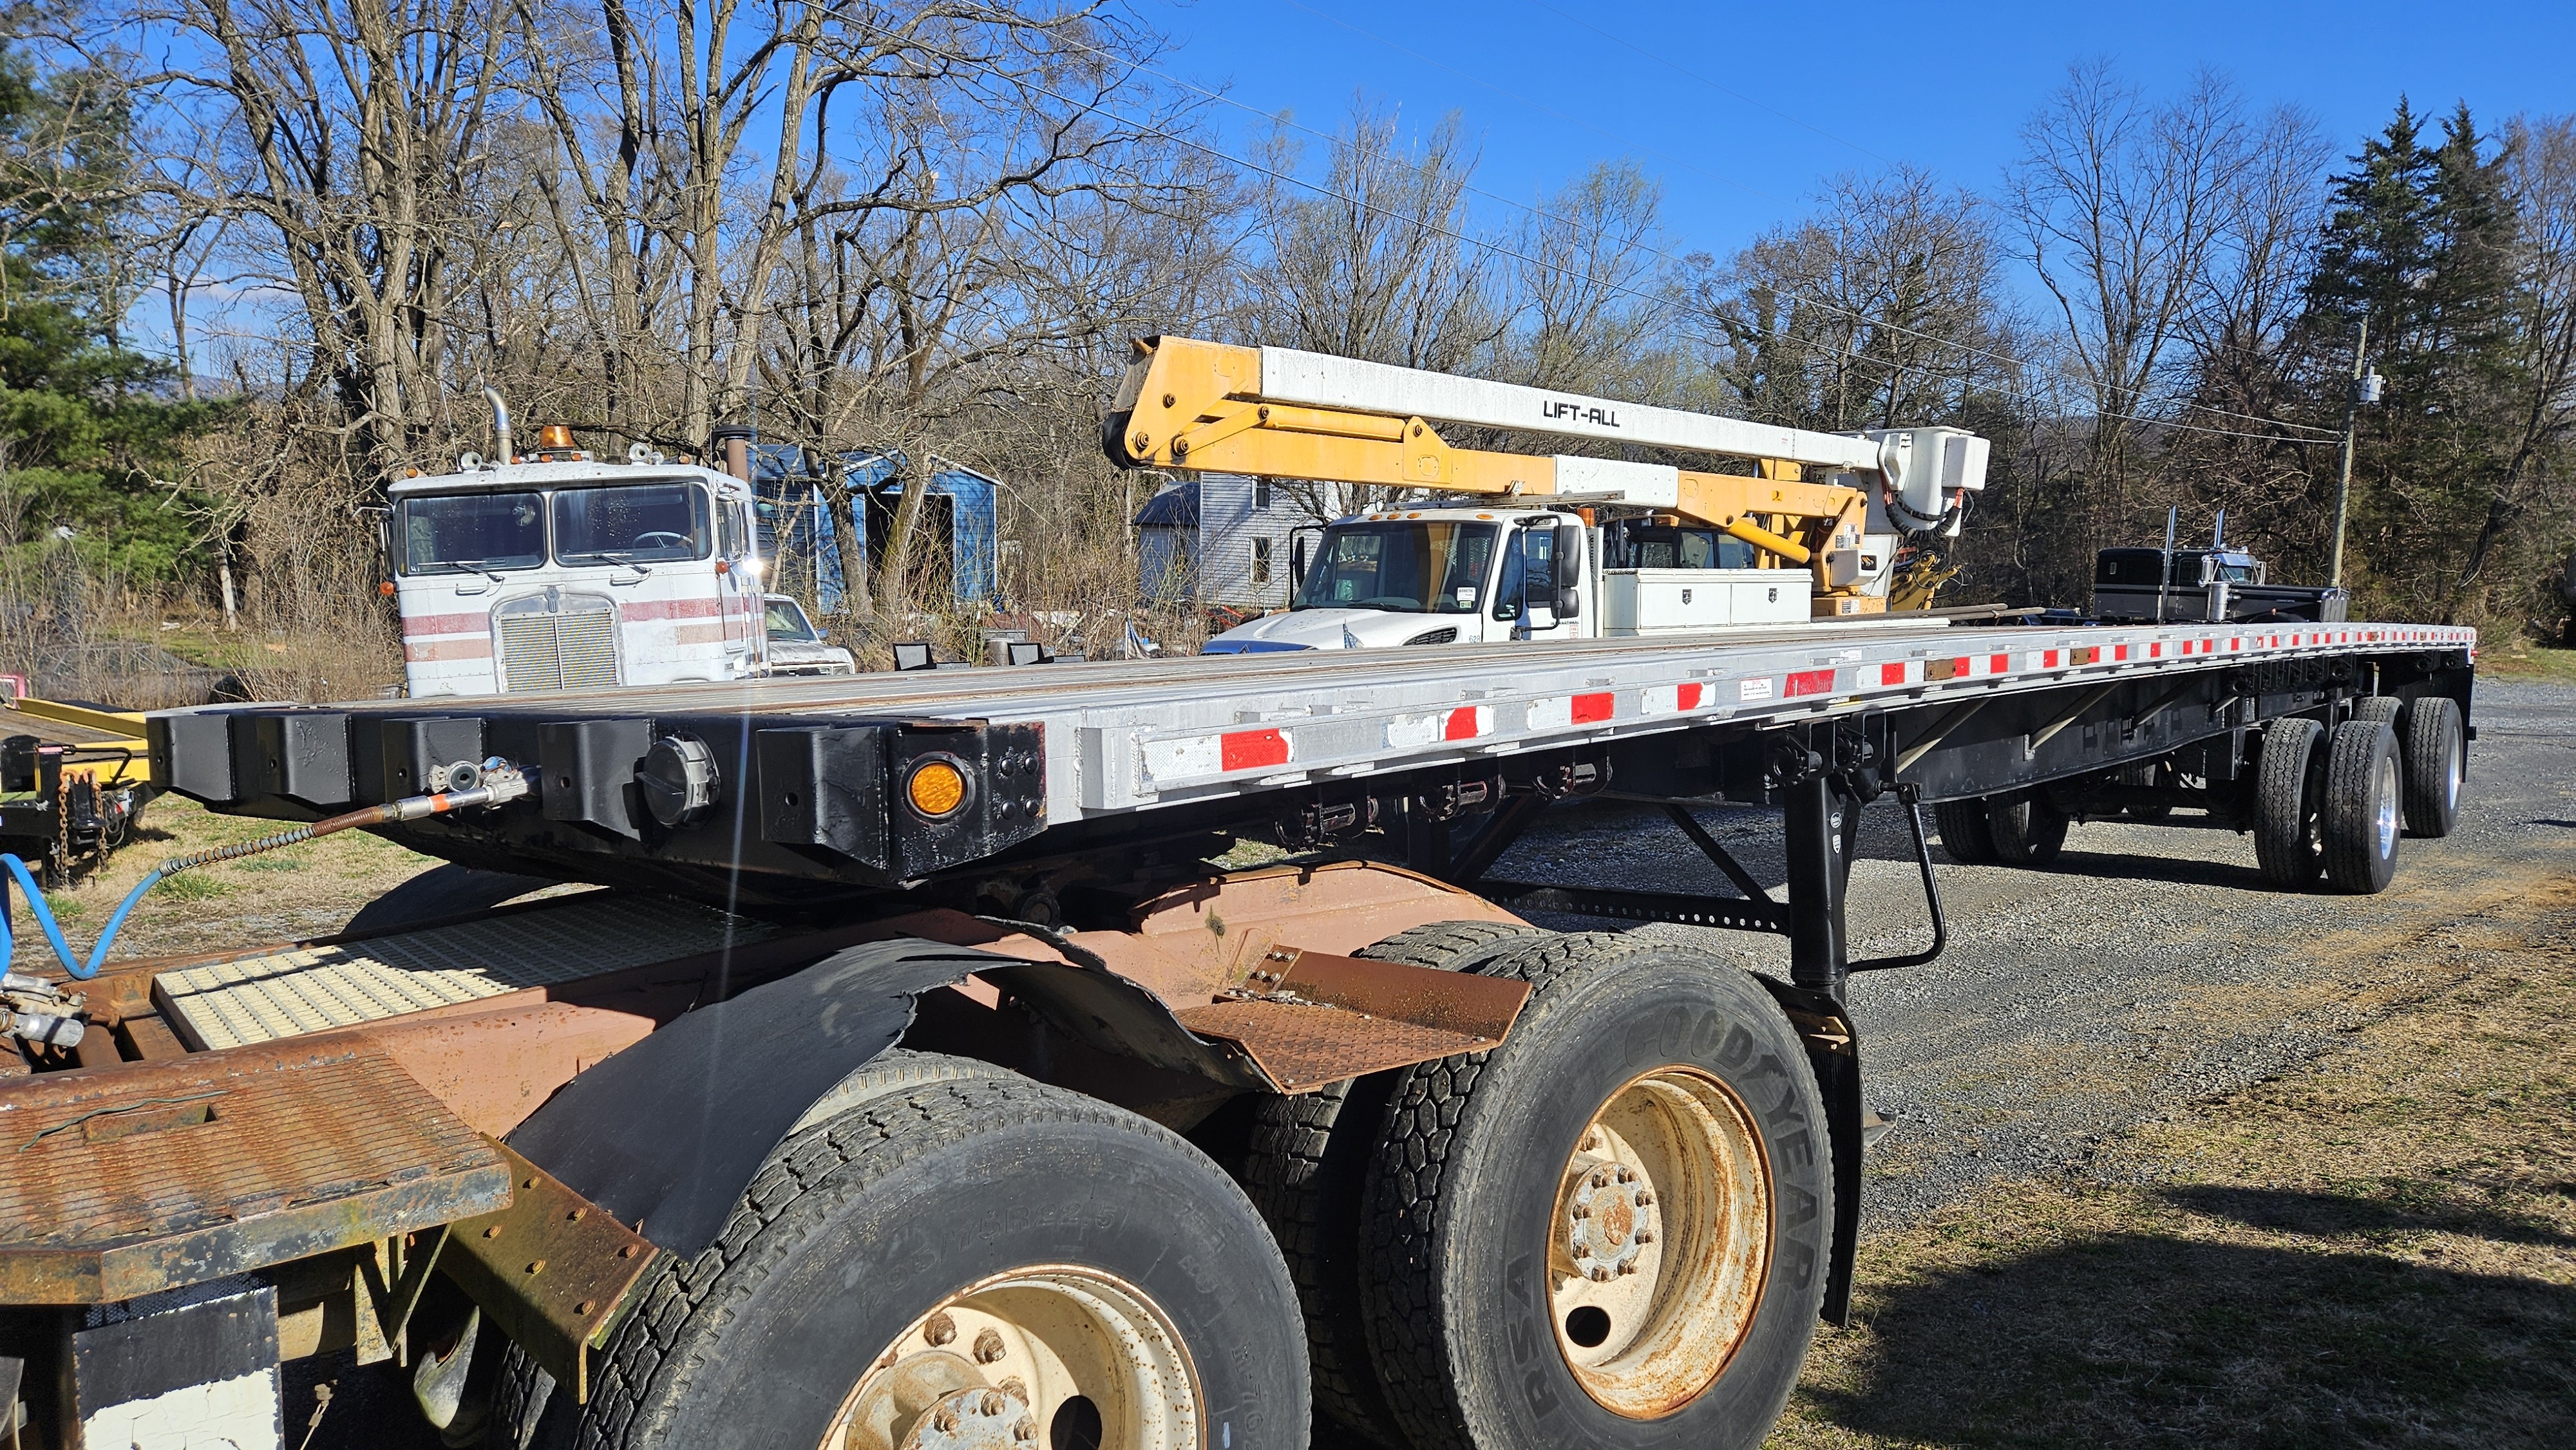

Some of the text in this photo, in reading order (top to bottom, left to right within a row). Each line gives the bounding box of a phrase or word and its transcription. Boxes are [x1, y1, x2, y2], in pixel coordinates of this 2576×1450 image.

[1543, 400, 1620, 428] LIFT-ALL
[1469, 635, 1481, 643] 628
[1625, 1005, 1818, 1293] GOODYEAR
